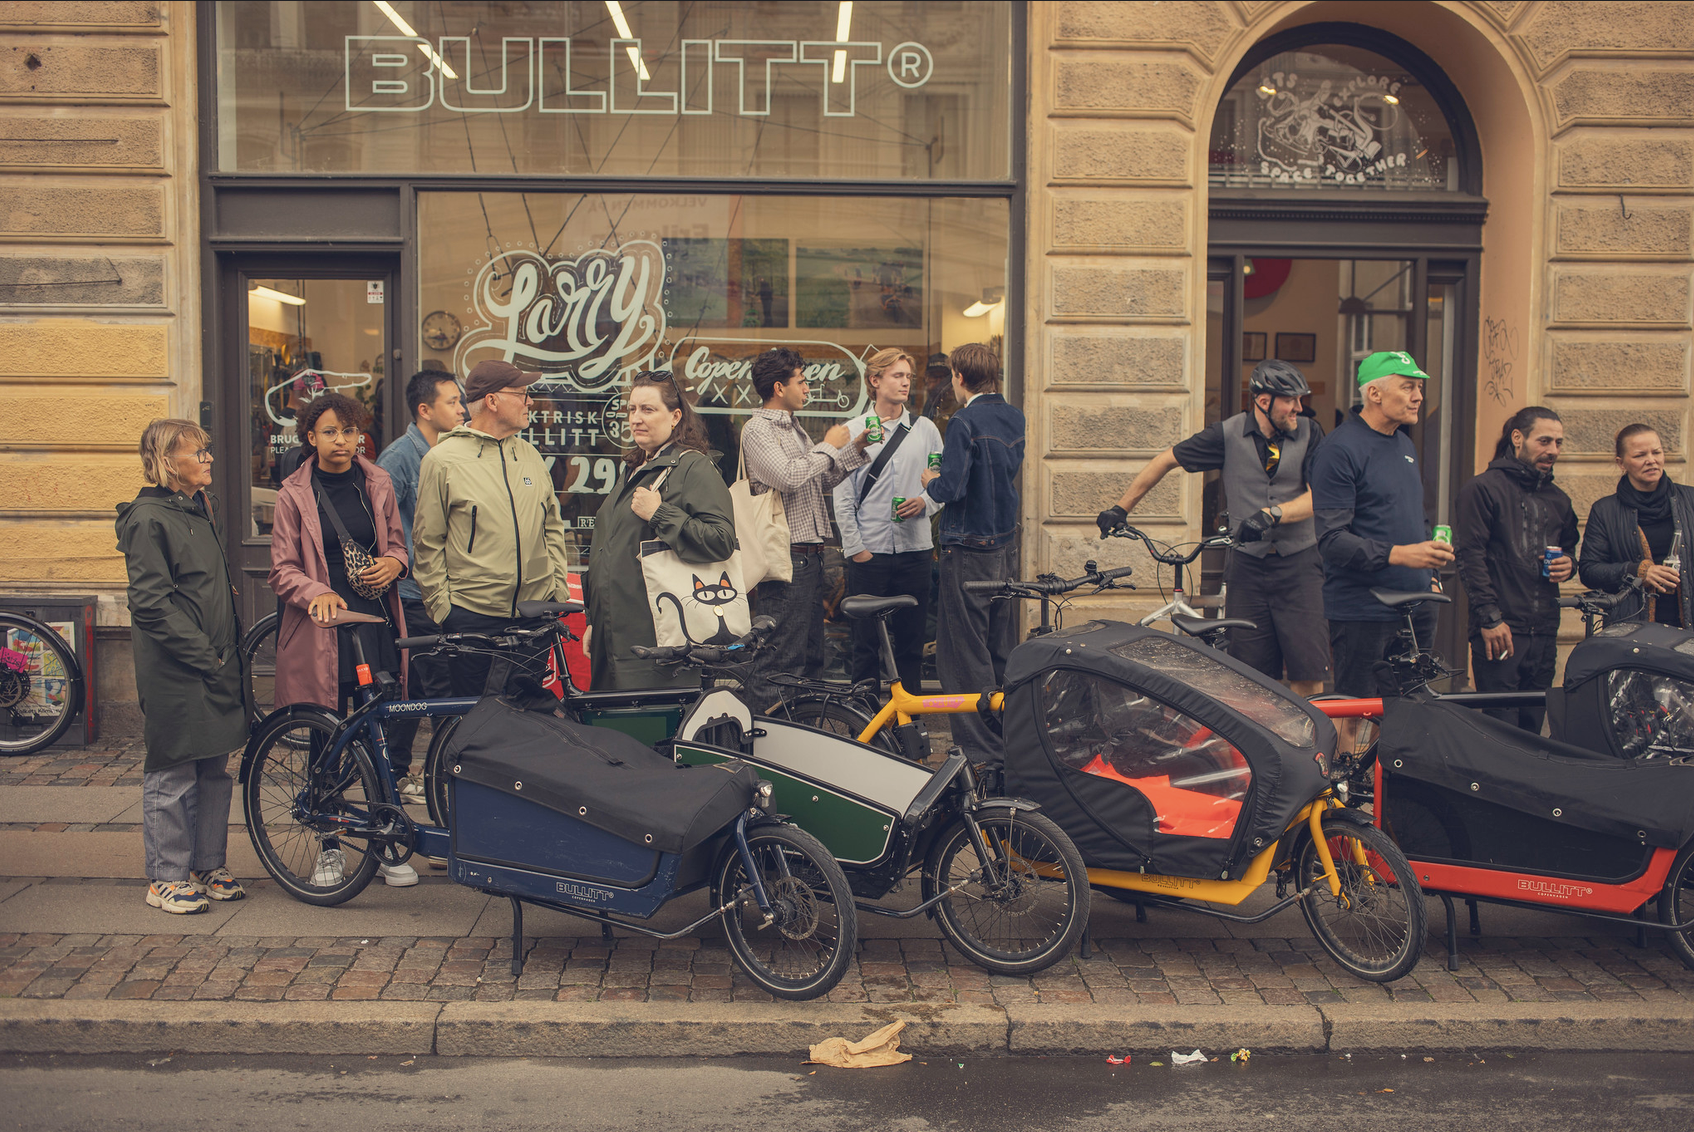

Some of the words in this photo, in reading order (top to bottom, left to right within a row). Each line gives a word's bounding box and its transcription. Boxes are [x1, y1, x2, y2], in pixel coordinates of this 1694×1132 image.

[1260, 161, 1313, 182] SPACE
[1325, 152, 1407, 184] TOGETHER
[684, 346, 846, 395] Copenen
[388, 702, 428, 713] MOONDOG
